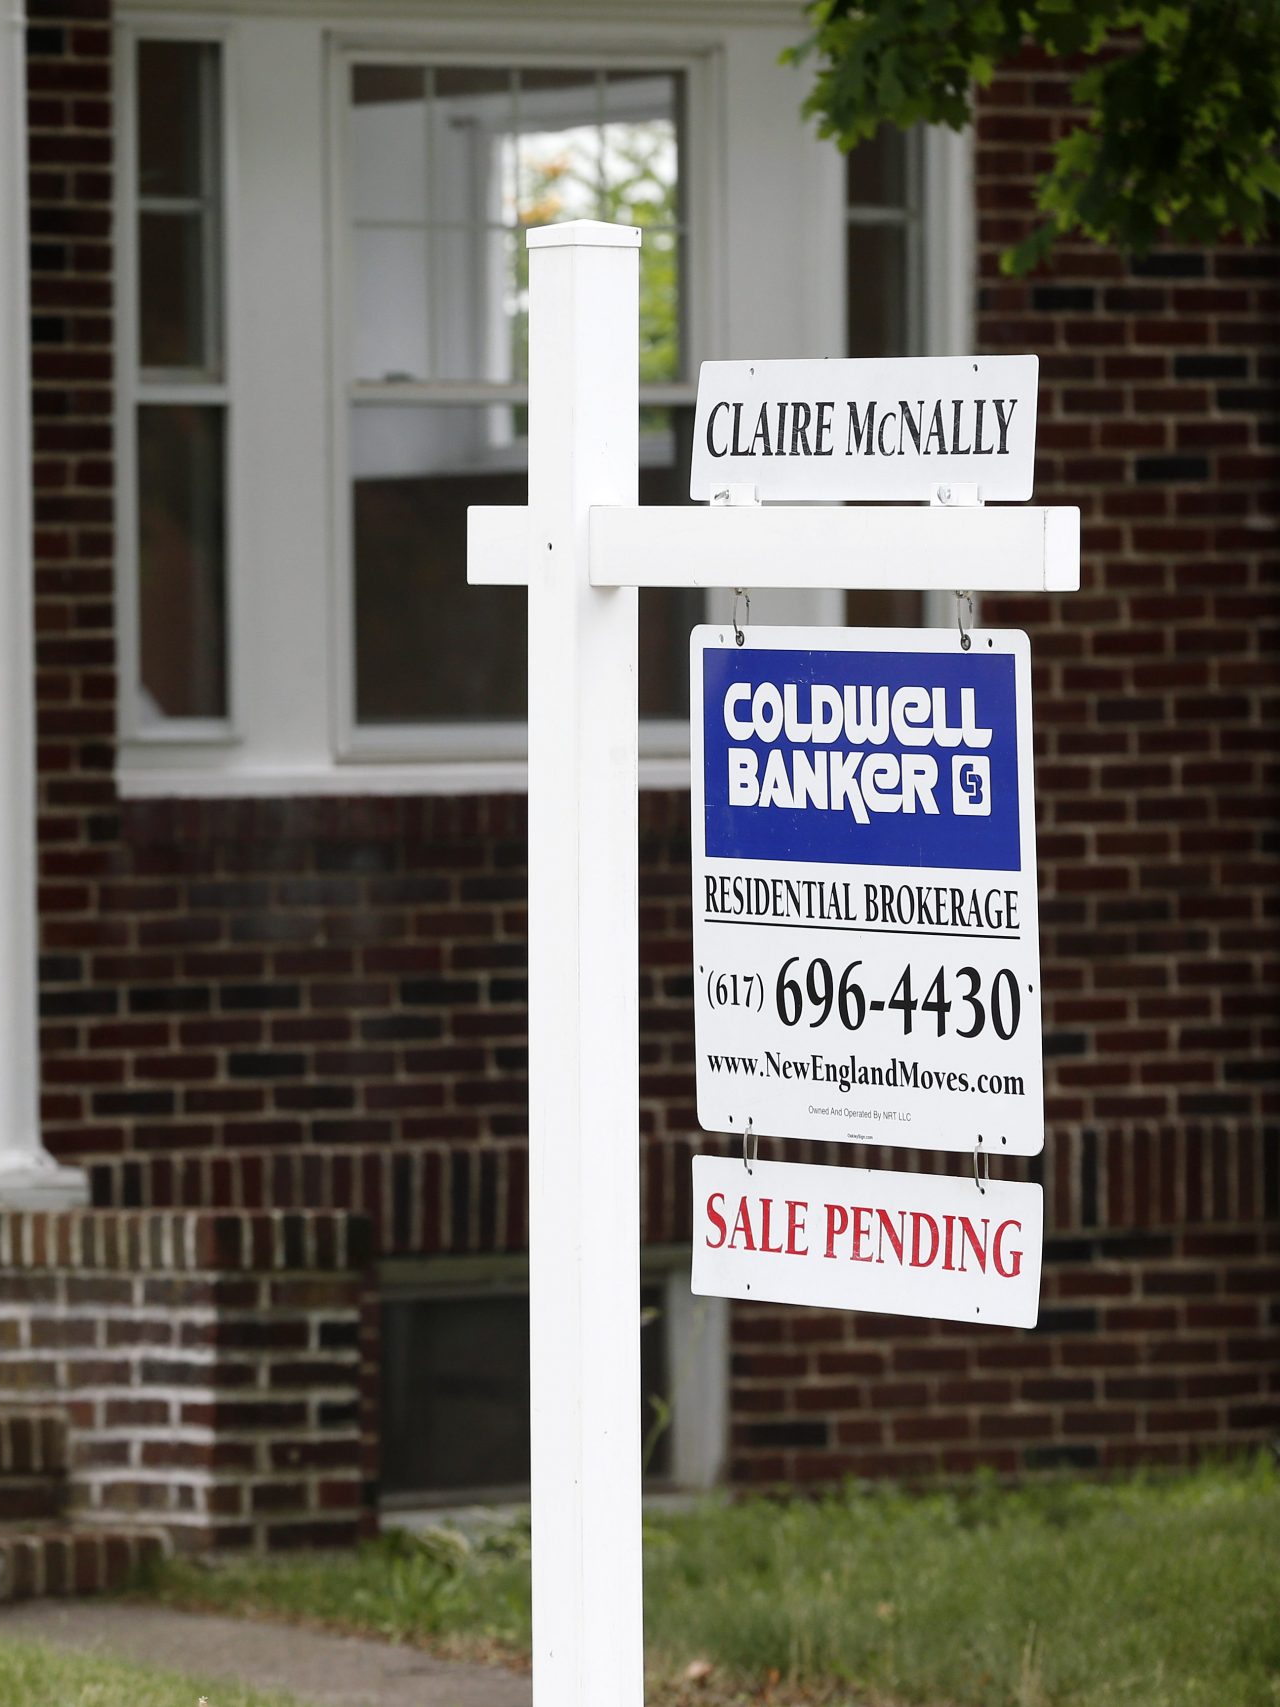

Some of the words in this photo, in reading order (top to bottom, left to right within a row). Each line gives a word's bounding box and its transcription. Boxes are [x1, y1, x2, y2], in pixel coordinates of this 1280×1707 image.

[706, 400, 835, 458] CLAIRE
[845, 398, 1018, 457] McNALLY
[728, 747, 940, 825] BANKER
[704, 875, 857, 921] RESIDENTIAL
[864, 883, 1020, 930] BROKERAGE
[707, 970, 765, 1013] (617)
[775, 956, 1021, 1041] 696-4430
[707, 1051, 1026, 1096] www.NewEnglandMoves.com
[808, 1105, 830, 1116] Owned
[830, 1107, 842, 1117] And
[844, 1108, 872, 1119] Operated
[873, 1110, 881, 1121] By
[882, 1111, 897, 1120] NRT
[898, 1112, 912, 1122] LLC
[705, 1192, 809, 1256] SALE
[823, 1203, 1024, 1278] PENDING
